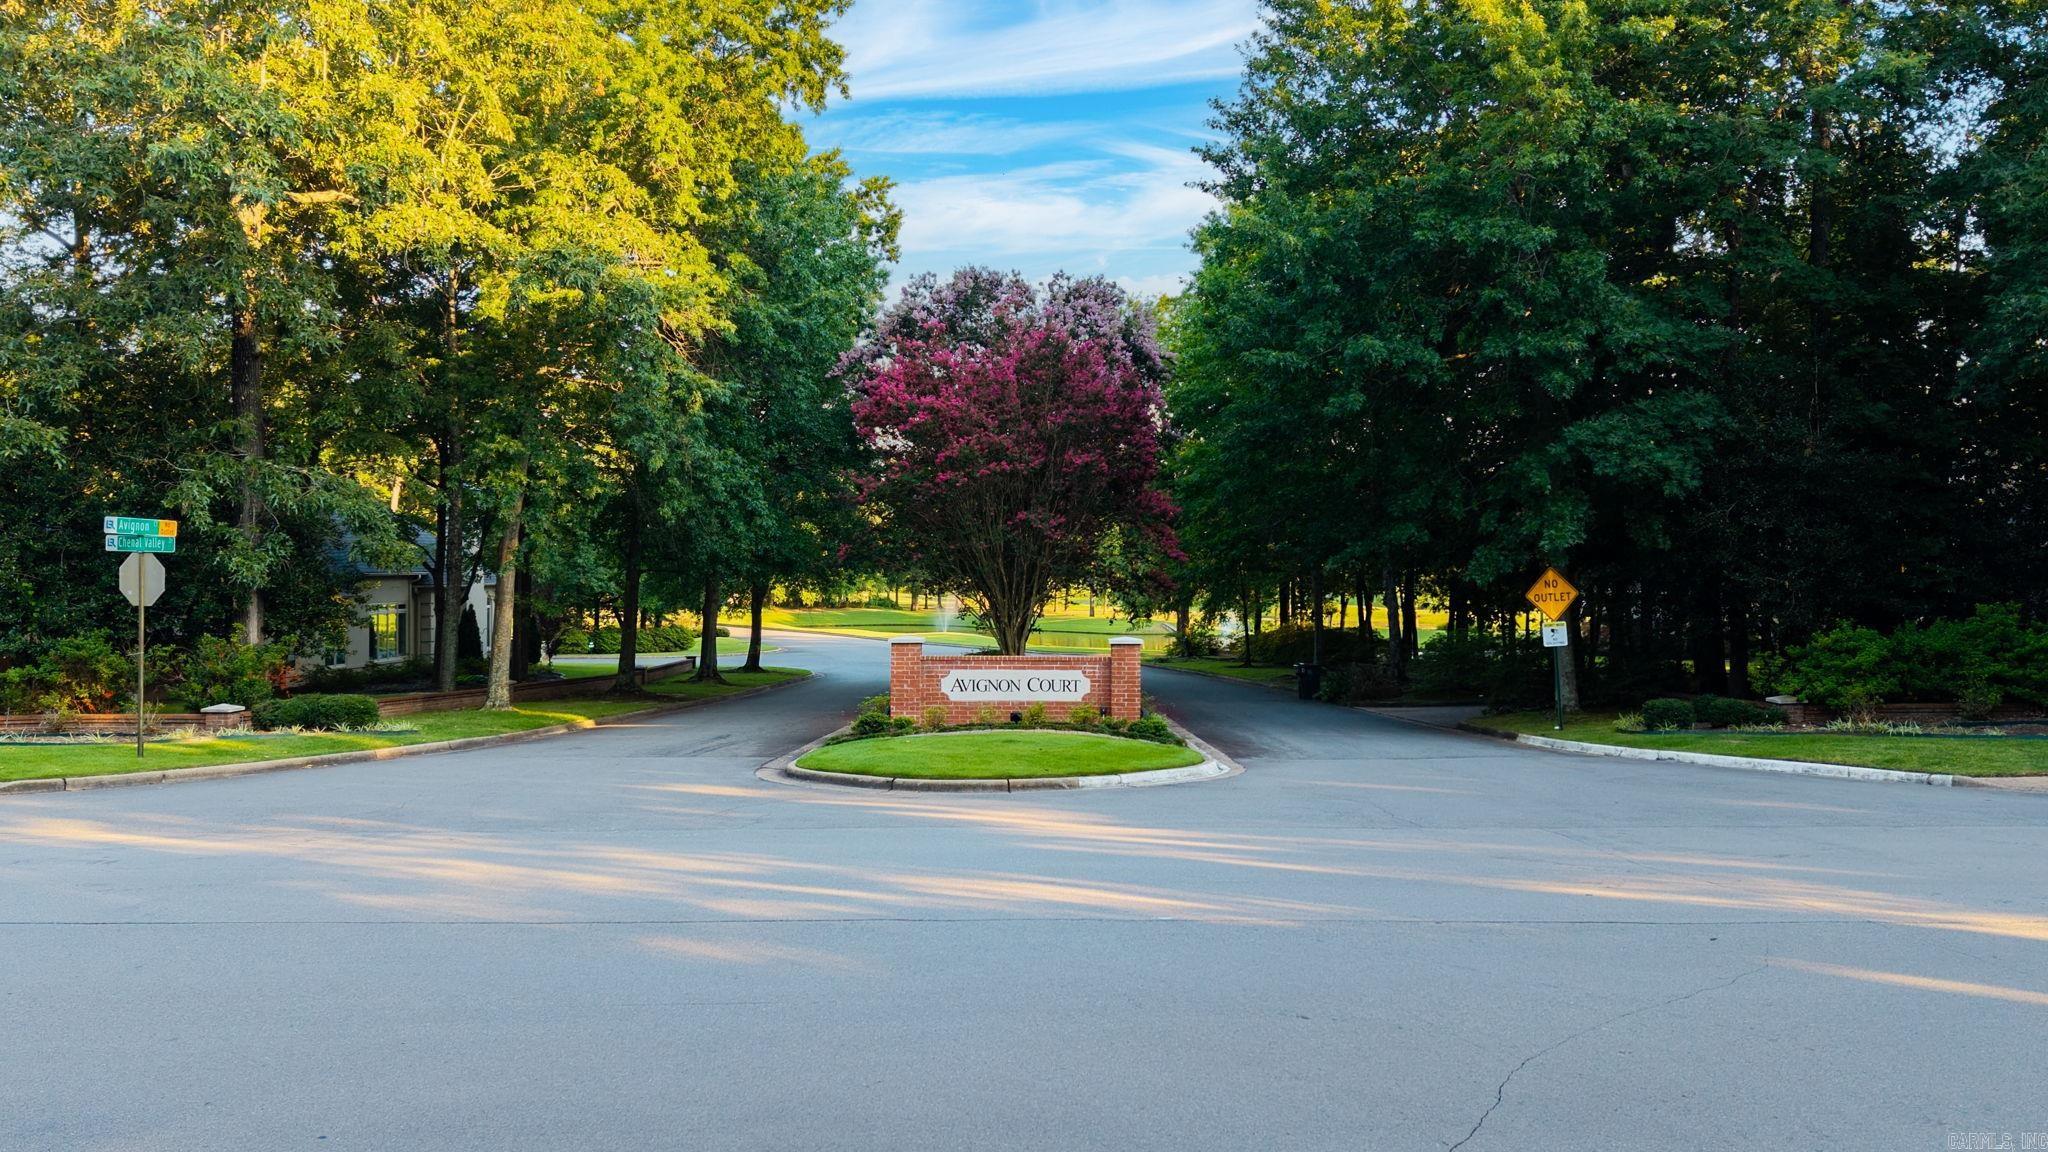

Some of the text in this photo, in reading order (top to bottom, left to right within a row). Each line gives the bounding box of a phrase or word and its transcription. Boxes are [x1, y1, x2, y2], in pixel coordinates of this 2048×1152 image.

[118, 520, 150, 533] Avignon
[118, 536, 142, 548] Chenal
[144, 537, 165, 551] Valley
[1544, 580, 1558, 589] NO
[1534, 592, 1571, 602] OUTLET
[950, 677, 1081, 693] AVIGNON COURT
